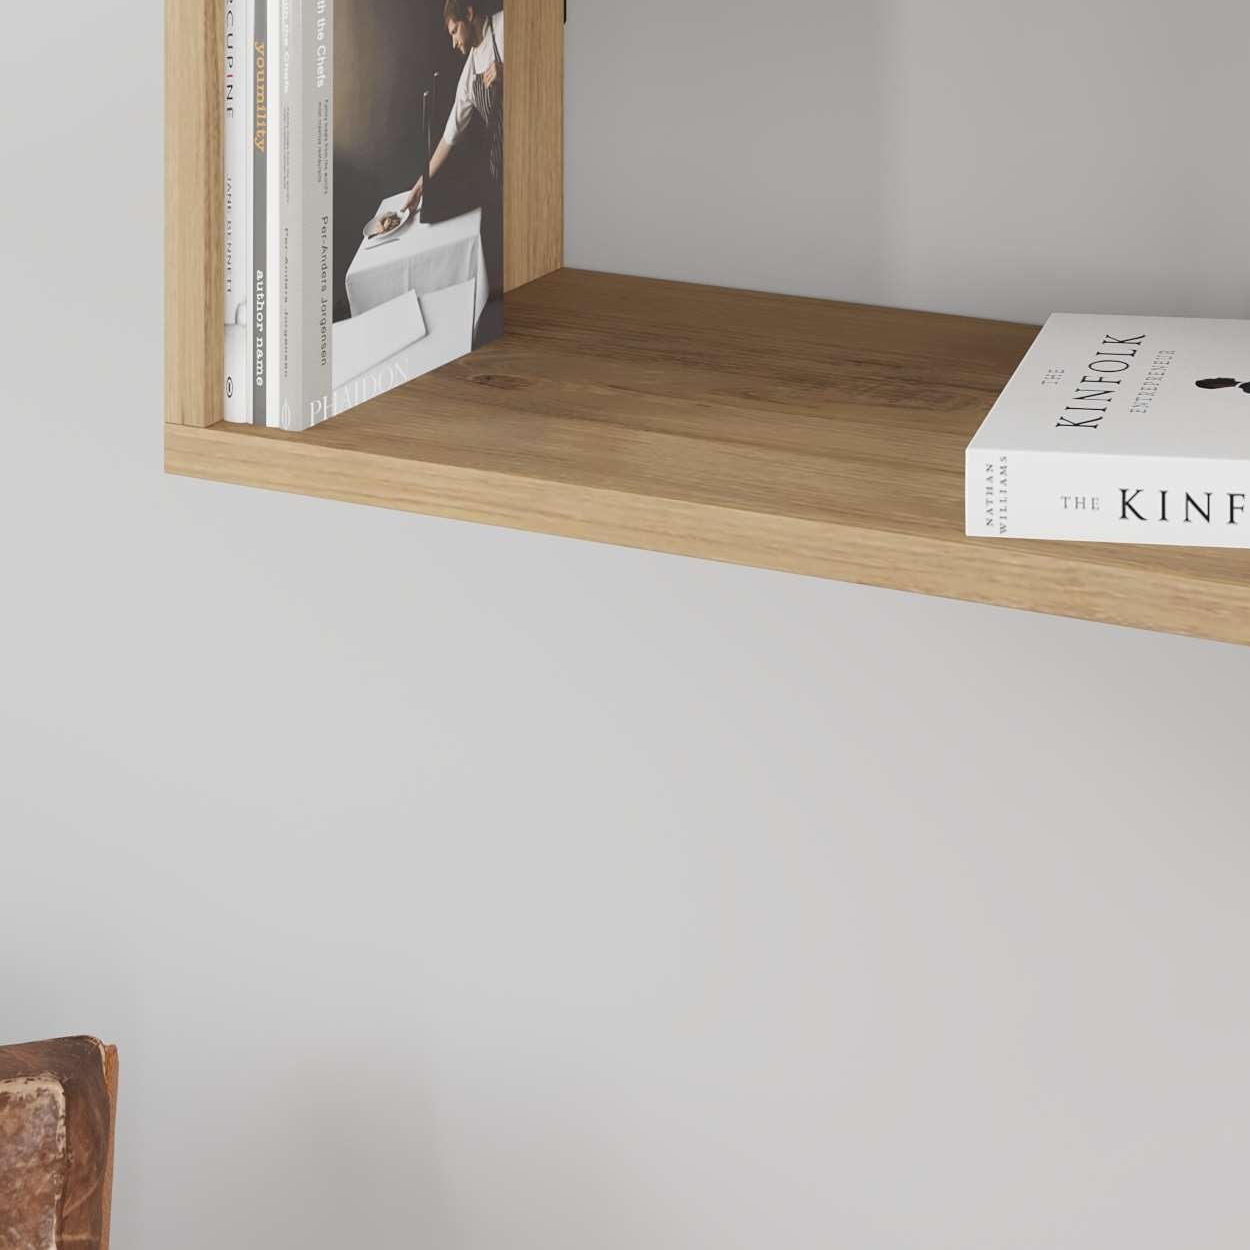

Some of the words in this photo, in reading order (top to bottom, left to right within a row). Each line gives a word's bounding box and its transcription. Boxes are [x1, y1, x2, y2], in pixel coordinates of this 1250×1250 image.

[316, 17, 327, 40] the
[254, 41, 267, 153] youmility
[316, 45, 327, 88] Chefs
[321, 215, 329, 292] Per-Anders
[256, 269, 265, 333] author
[256, 337, 264, 387] name
[309, 357, 408, 427] PHAIDON
[1041, 367, 1064, 385] THE
[1055, 334, 1146, 429] KINFOLK
[1129, 350, 1175, 414] ENTREPRENEUR
[985, 463, 994, 526] NATHAN
[999, 456, 1007, 534] WILLIAMS
[1060, 495, 1100, 511] THE
